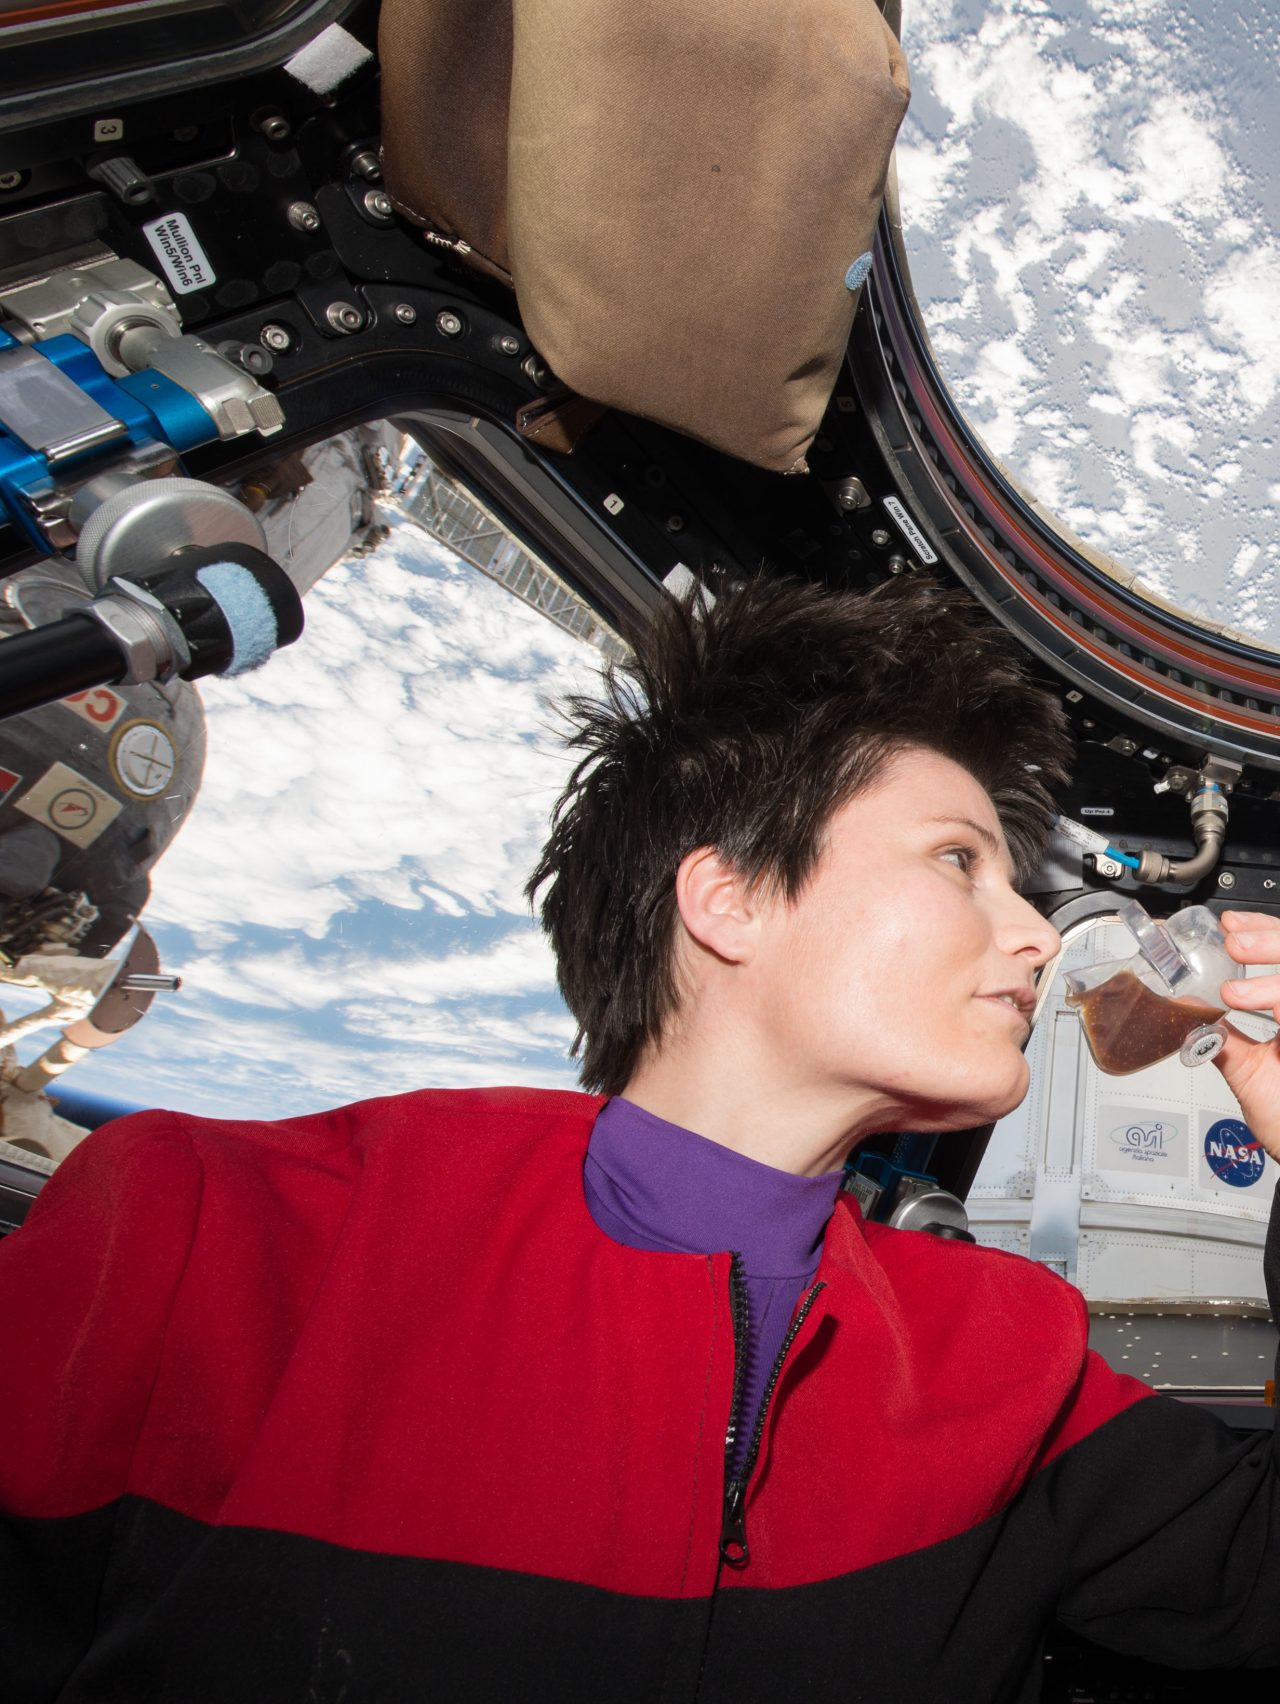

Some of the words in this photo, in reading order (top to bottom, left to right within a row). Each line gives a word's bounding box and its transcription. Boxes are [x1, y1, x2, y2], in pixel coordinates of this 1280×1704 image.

[100, 125, 117, 135] 3
[155, 225, 192, 286] Win5/Win6
[166, 219, 193, 262] Mullion
[189, 264, 206, 283] Pnl
[894, 506, 904, 519] Win
[903, 519, 916, 535] Pane
[914, 536, 932, 560] Scratch
[1210, 1141, 1263, 1166] NASA
